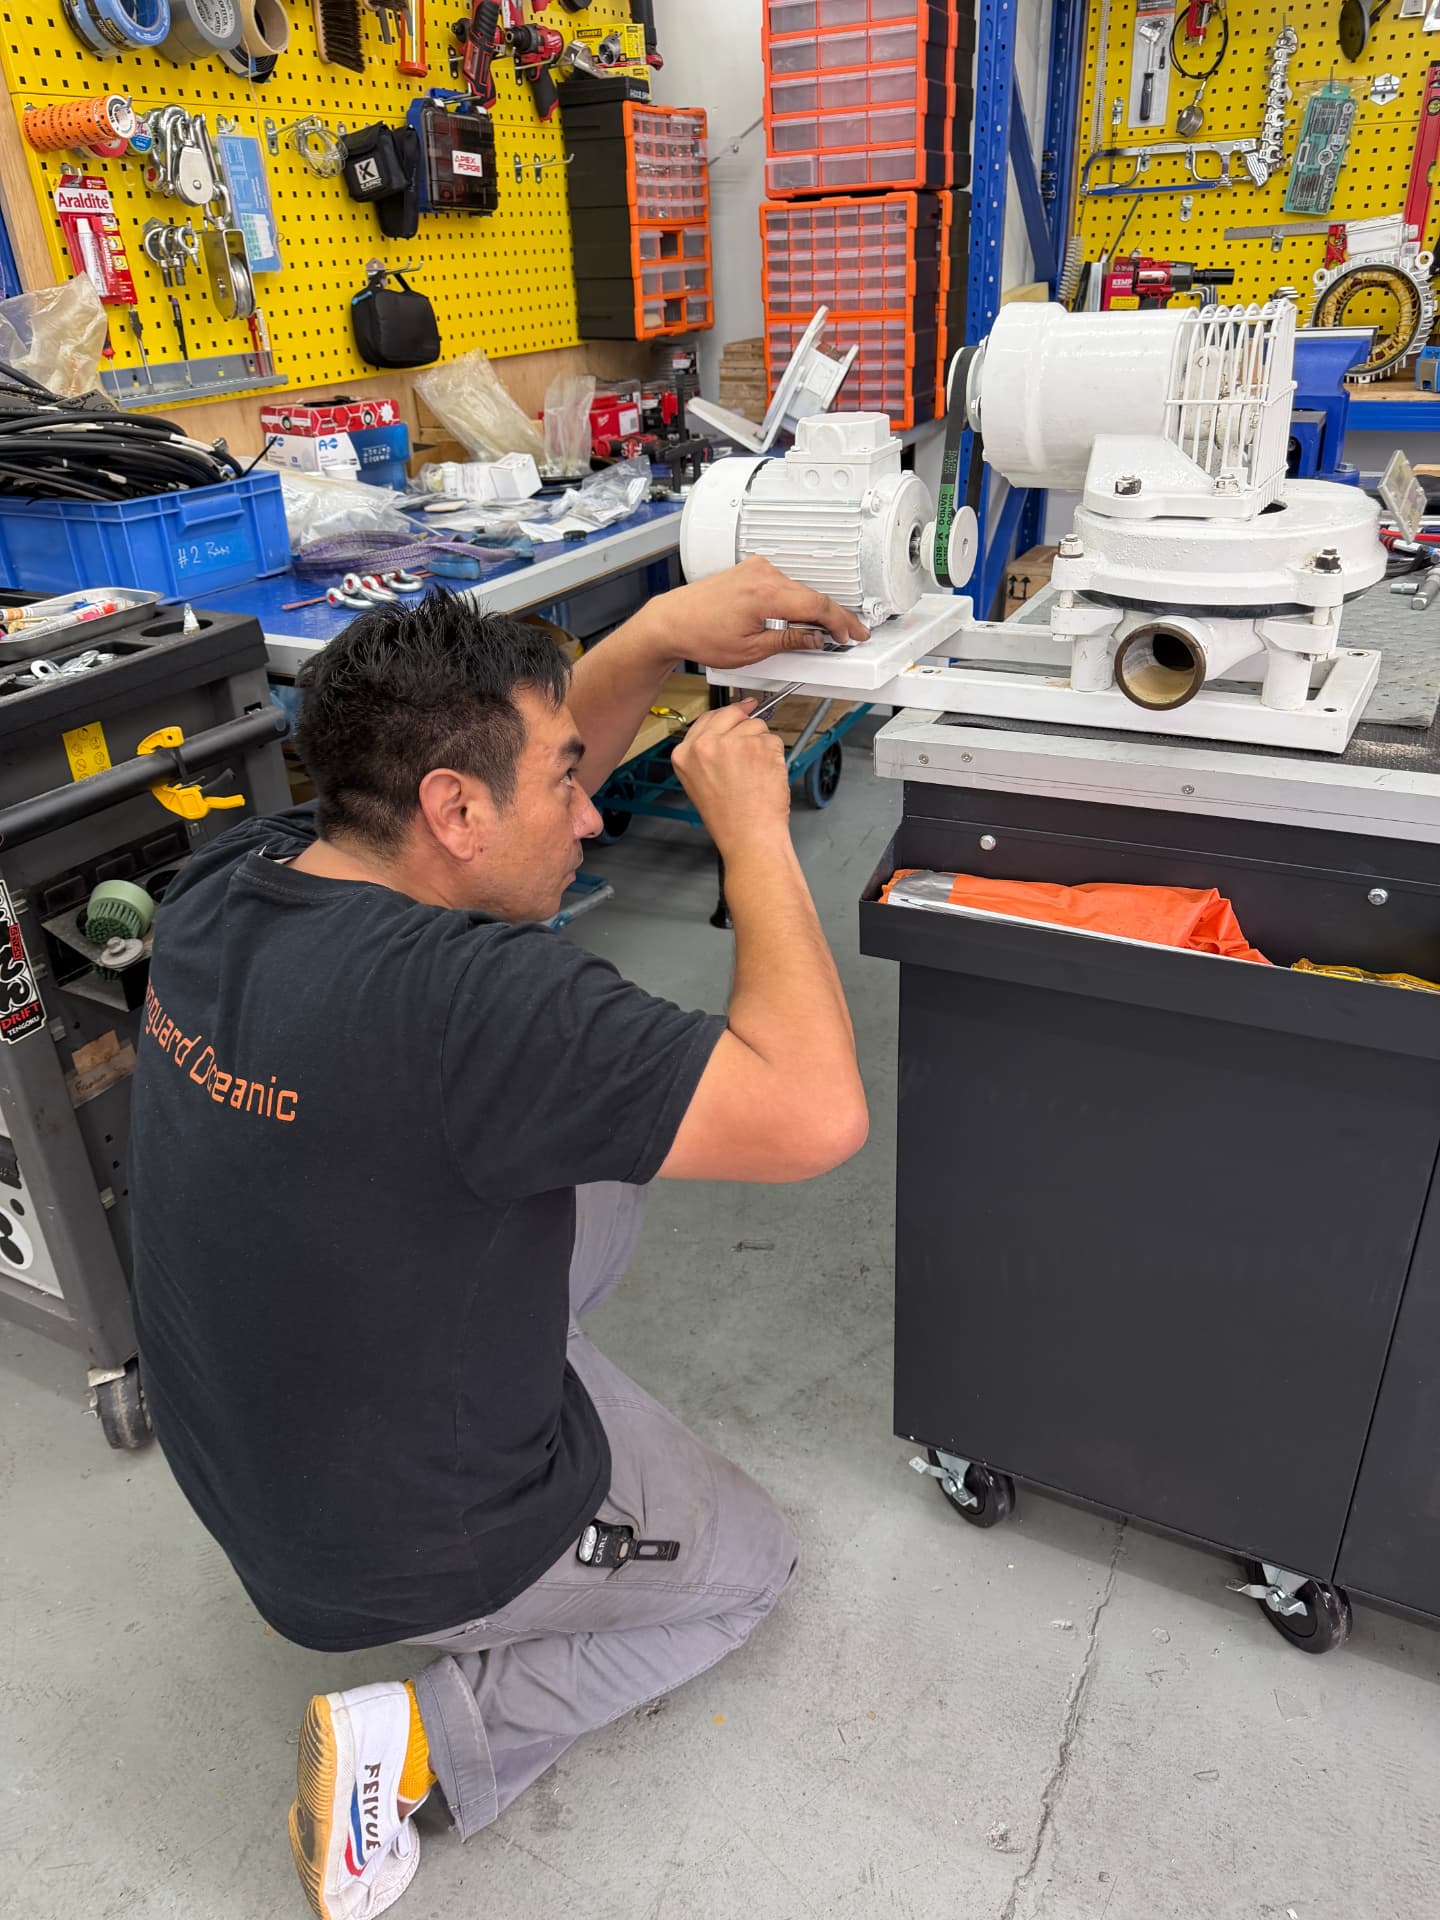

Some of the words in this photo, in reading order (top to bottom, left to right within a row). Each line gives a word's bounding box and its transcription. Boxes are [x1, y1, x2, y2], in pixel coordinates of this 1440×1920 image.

[58, 191, 110, 210] Araldite
[1, 1001, 40, 1031] DRIFT
[7, 1015, 40, 1036] TENGOKU
[189, 1045, 298, 1122] Oceanic
[363, 1762, 381, 1850] FEIYUE
